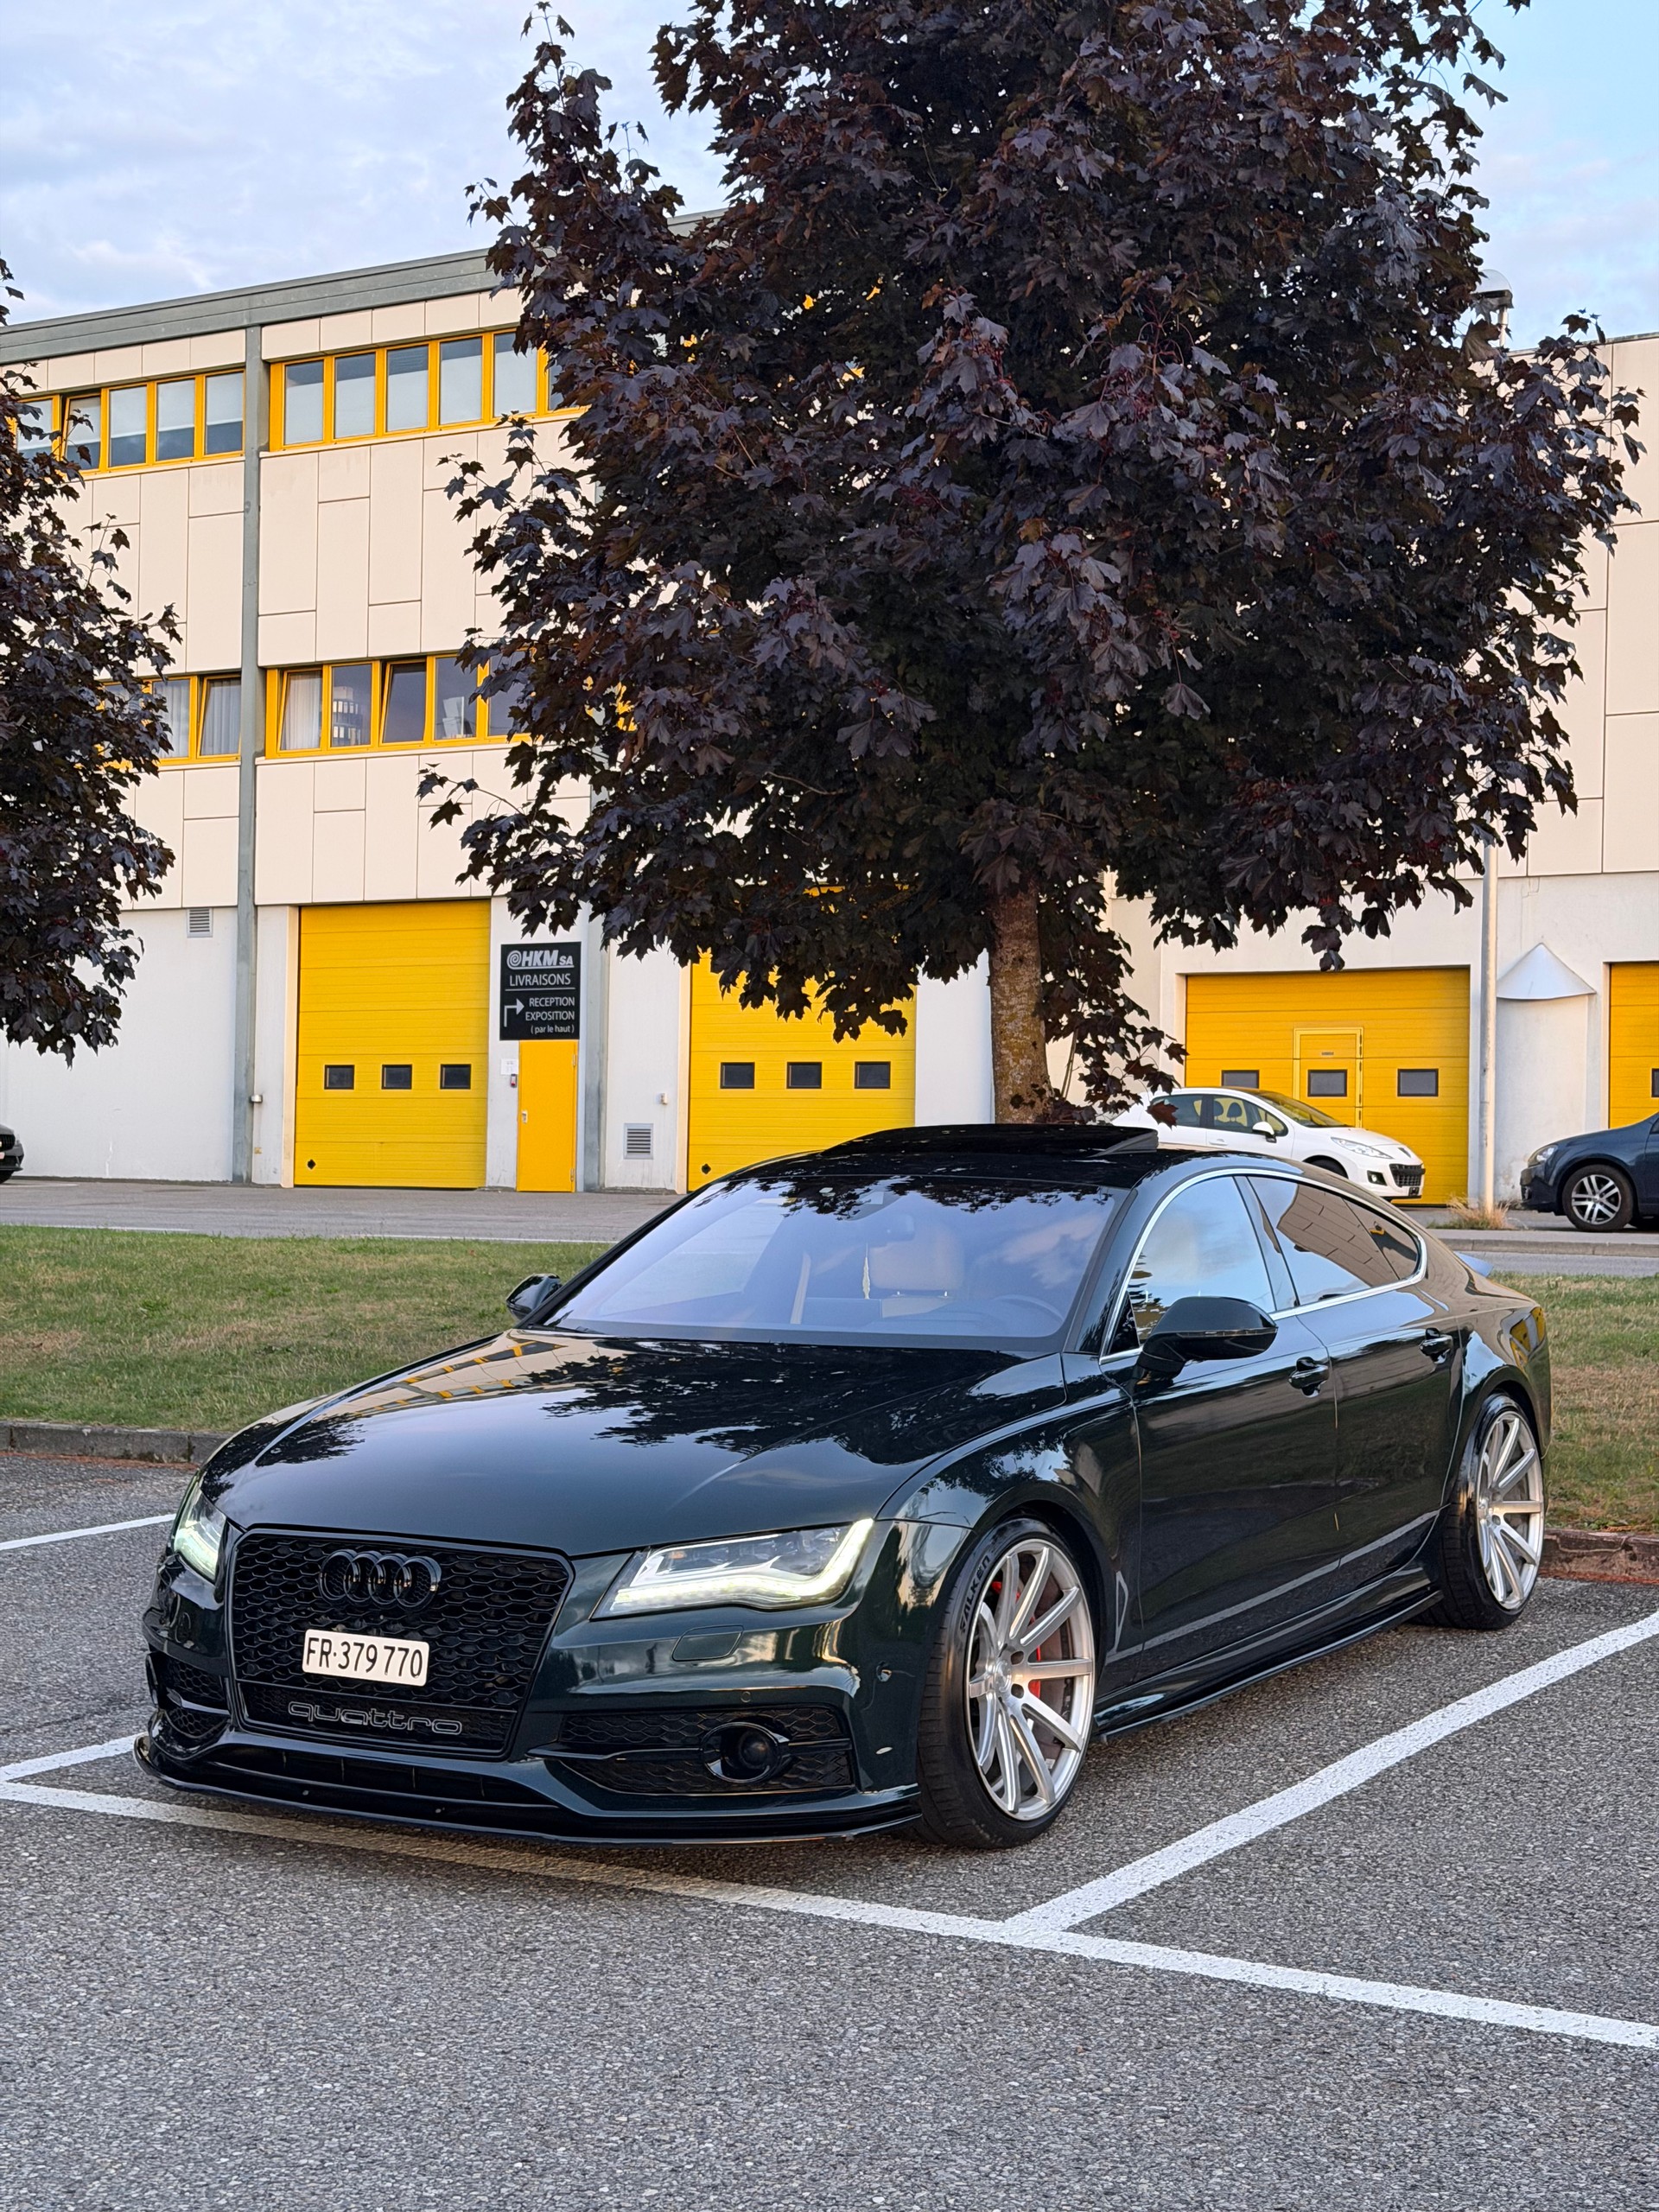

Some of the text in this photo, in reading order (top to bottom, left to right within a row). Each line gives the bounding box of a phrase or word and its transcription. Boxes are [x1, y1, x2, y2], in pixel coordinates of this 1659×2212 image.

[559, 956, 574, 965] SA
[509, 973, 571, 987] LIVRAISONS
[529, 996, 575, 1007] RECEPTION
[525, 1010, 575, 1021] EXPOSITION
[547, 1025, 554, 1033] le
[288, 1700, 462, 1735] quattro
